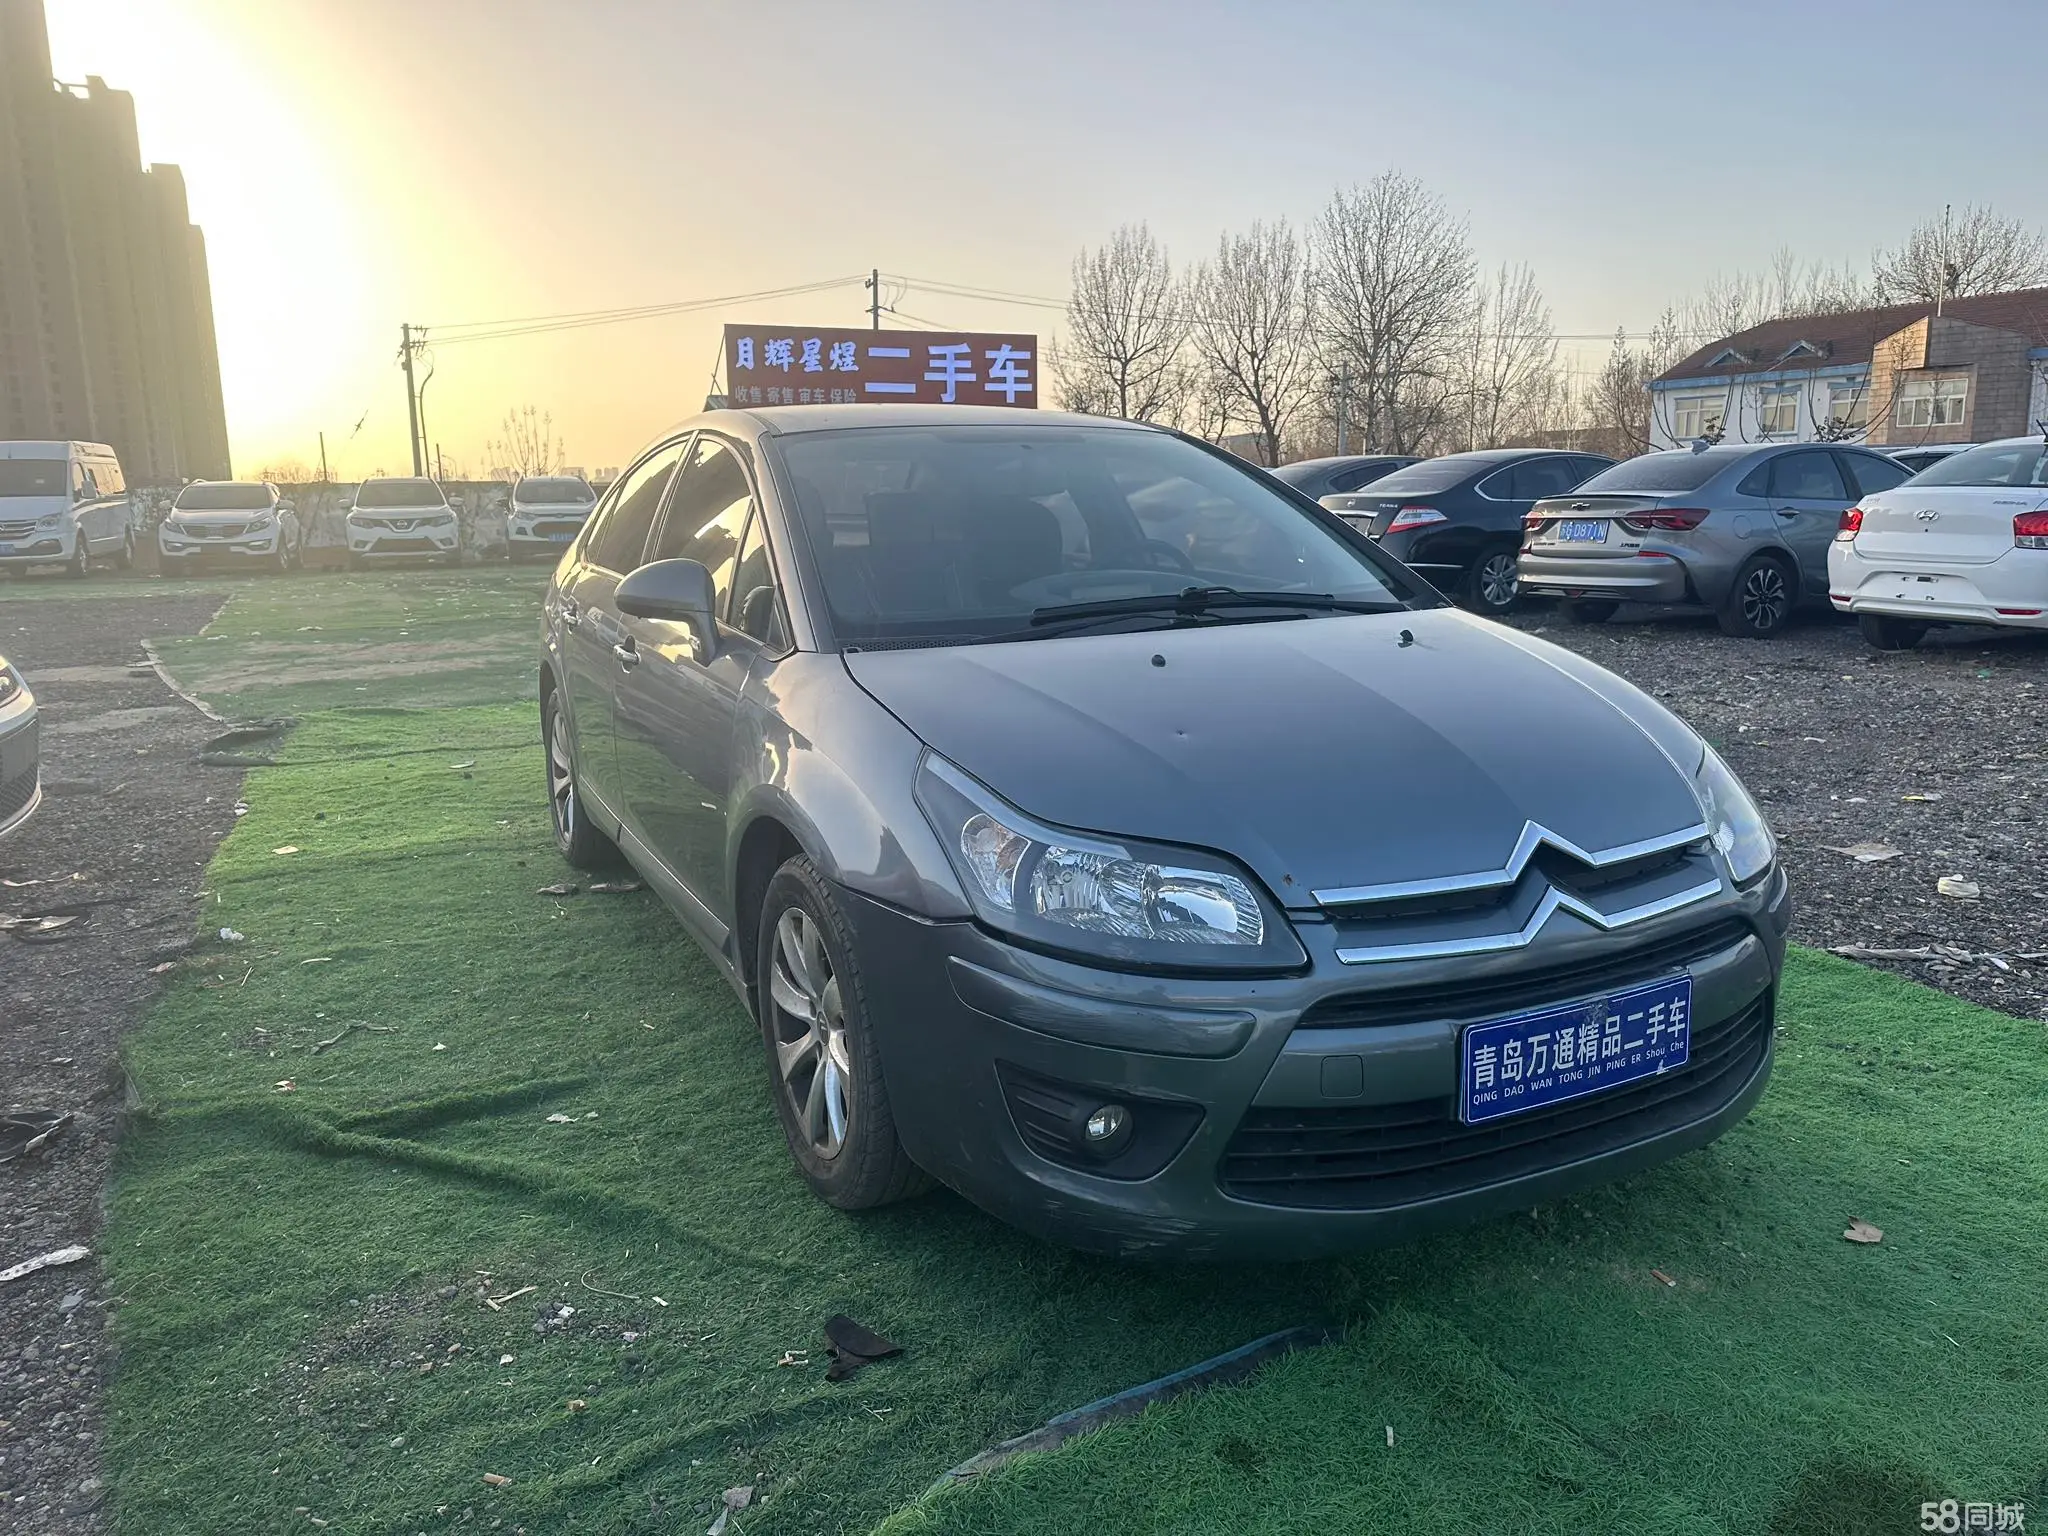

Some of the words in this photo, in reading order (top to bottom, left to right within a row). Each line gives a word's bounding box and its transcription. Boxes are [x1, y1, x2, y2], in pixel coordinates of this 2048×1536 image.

[735, 386, 761, 403] 收售
[767, 386, 794, 404] 寄售
[830, 388, 857, 403] 保险
[865, 343, 1033, 403] 二手车
[1473, 996, 1687, 1090] 青岛万通精品二手车
[1473, 1090, 1498, 1105] QING
[1504, 1084, 1525, 1098] DAO
[1531, 1077, 1553, 1091] WAN
[1559, 1069, 1583, 1084] TONG
[1588, 1064, 1601, 1079] JIN
[1606, 1057, 1626, 1072] PING
[1631, 1053, 1641, 1064] ER
[1646, 1047, 1666, 1060] Shou
[1670, 1040, 1685, 1052] Che
